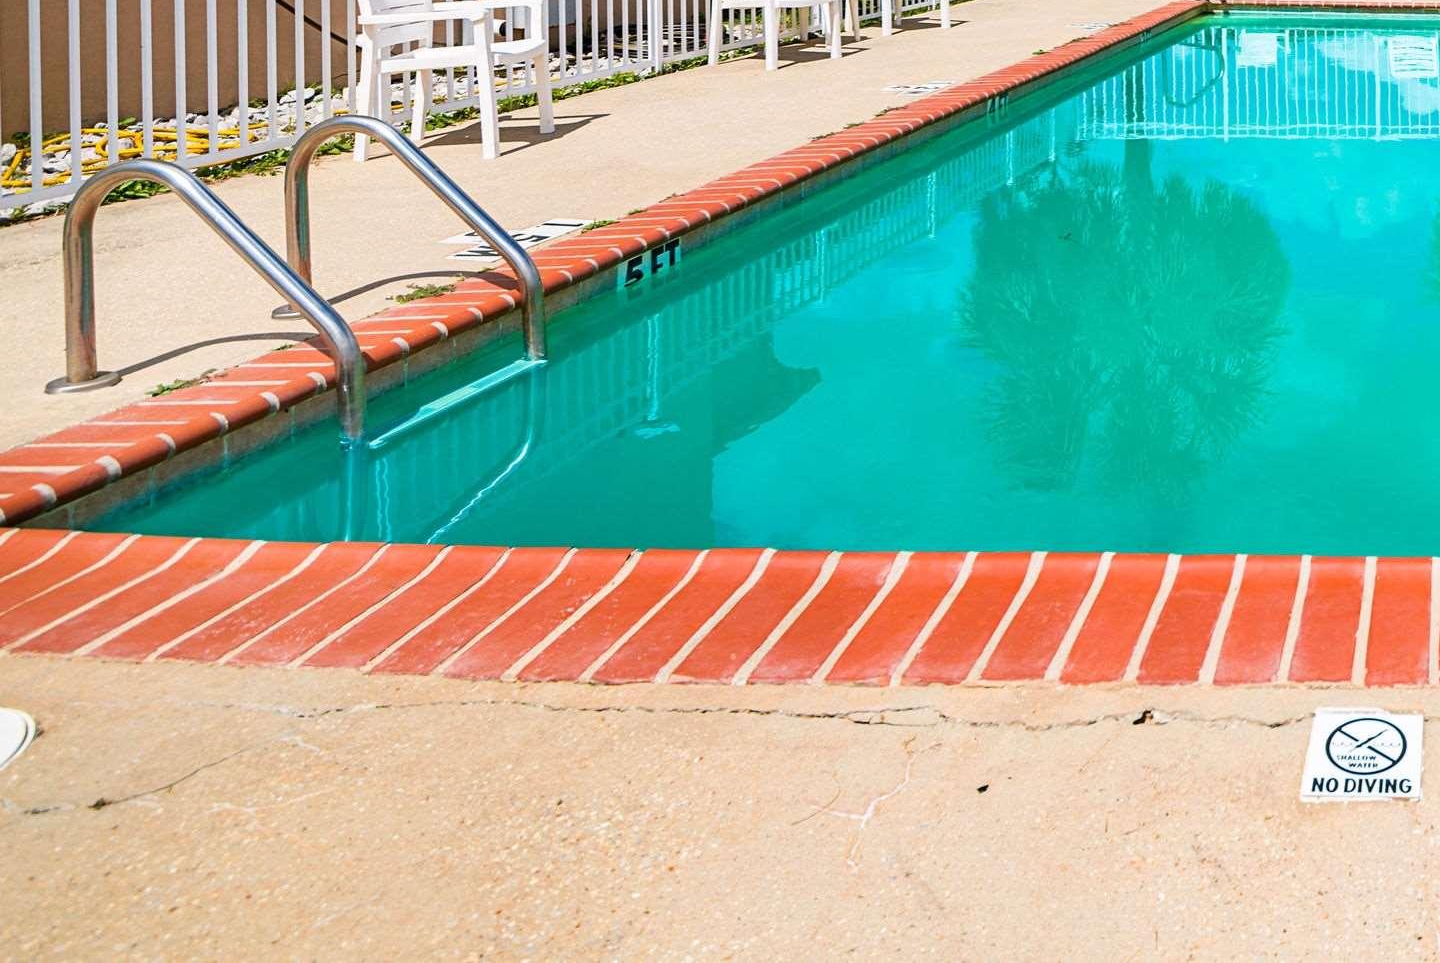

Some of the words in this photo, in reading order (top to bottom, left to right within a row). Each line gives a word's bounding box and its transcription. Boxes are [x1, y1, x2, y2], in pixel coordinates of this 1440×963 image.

[624, 255, 644, 287] 5
[651, 238, 680, 274] FT
[1311, 777, 1339, 793] NO
[1343, 778, 1412, 794] DIVING
